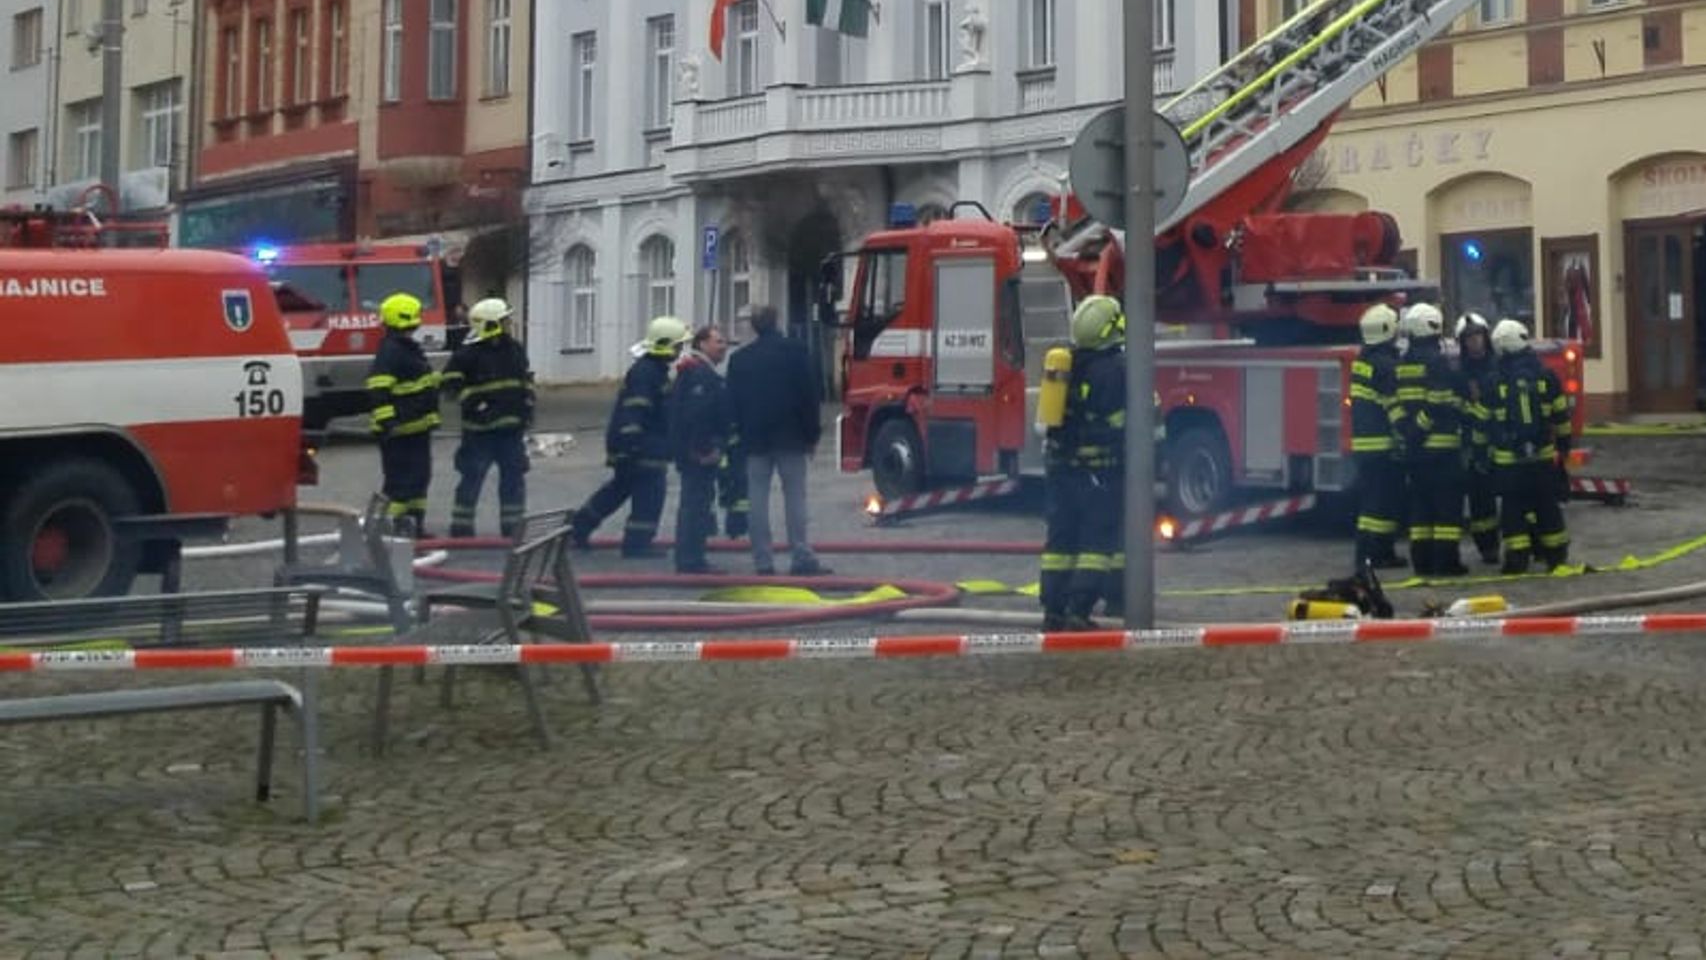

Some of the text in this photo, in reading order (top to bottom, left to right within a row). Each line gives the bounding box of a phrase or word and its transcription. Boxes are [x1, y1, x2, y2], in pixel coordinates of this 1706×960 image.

[0, 277, 106, 296] AJNICE
[327, 313, 382, 329] HASIČ
[233, 389, 285, 417] 150
